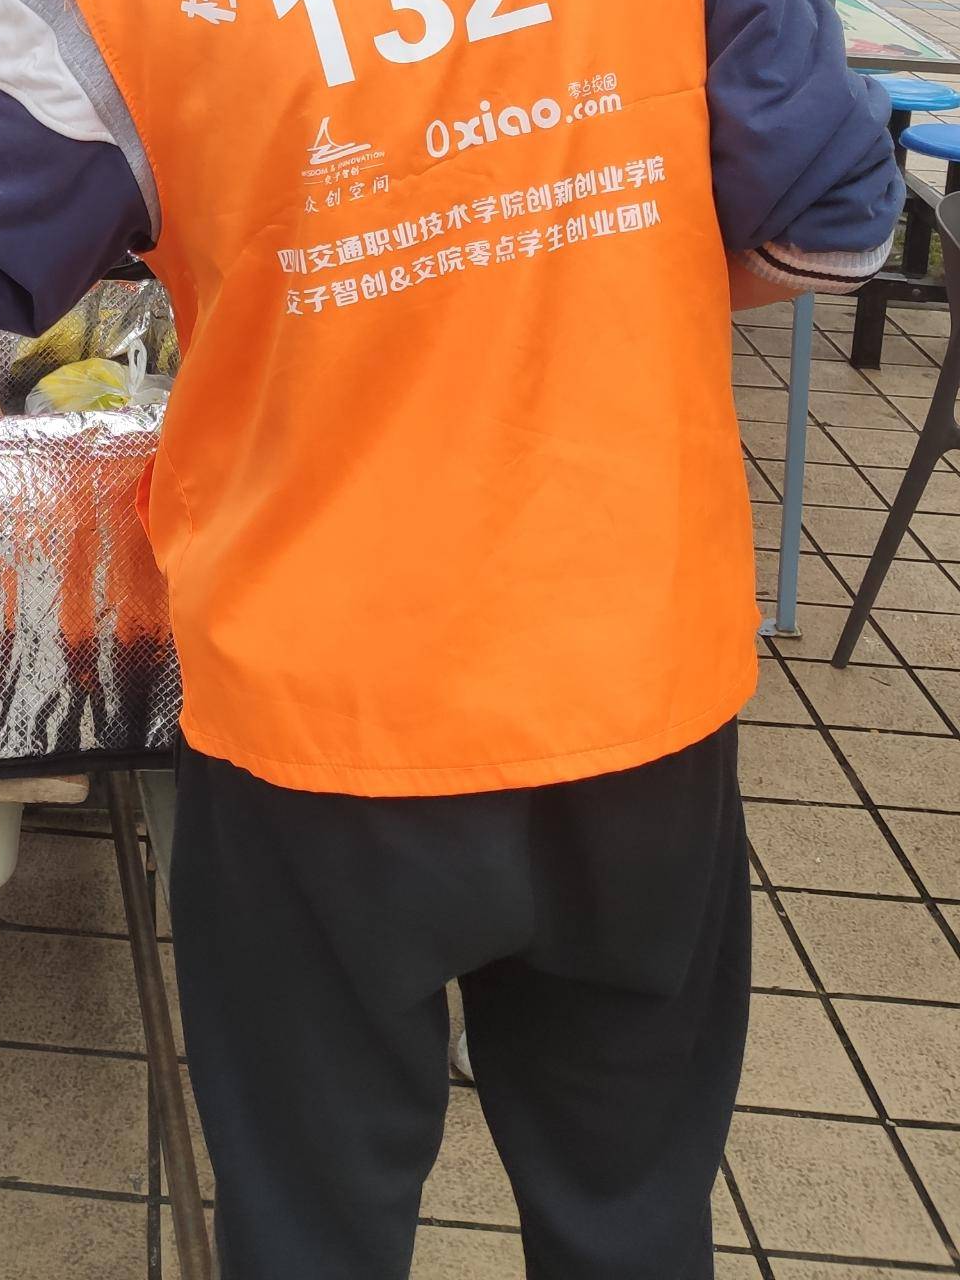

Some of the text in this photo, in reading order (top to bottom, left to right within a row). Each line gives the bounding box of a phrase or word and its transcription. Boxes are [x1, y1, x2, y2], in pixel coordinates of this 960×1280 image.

[426, 93, 623, 158] 0xiao.com
[304, 174, 390, 214] 众创空间
